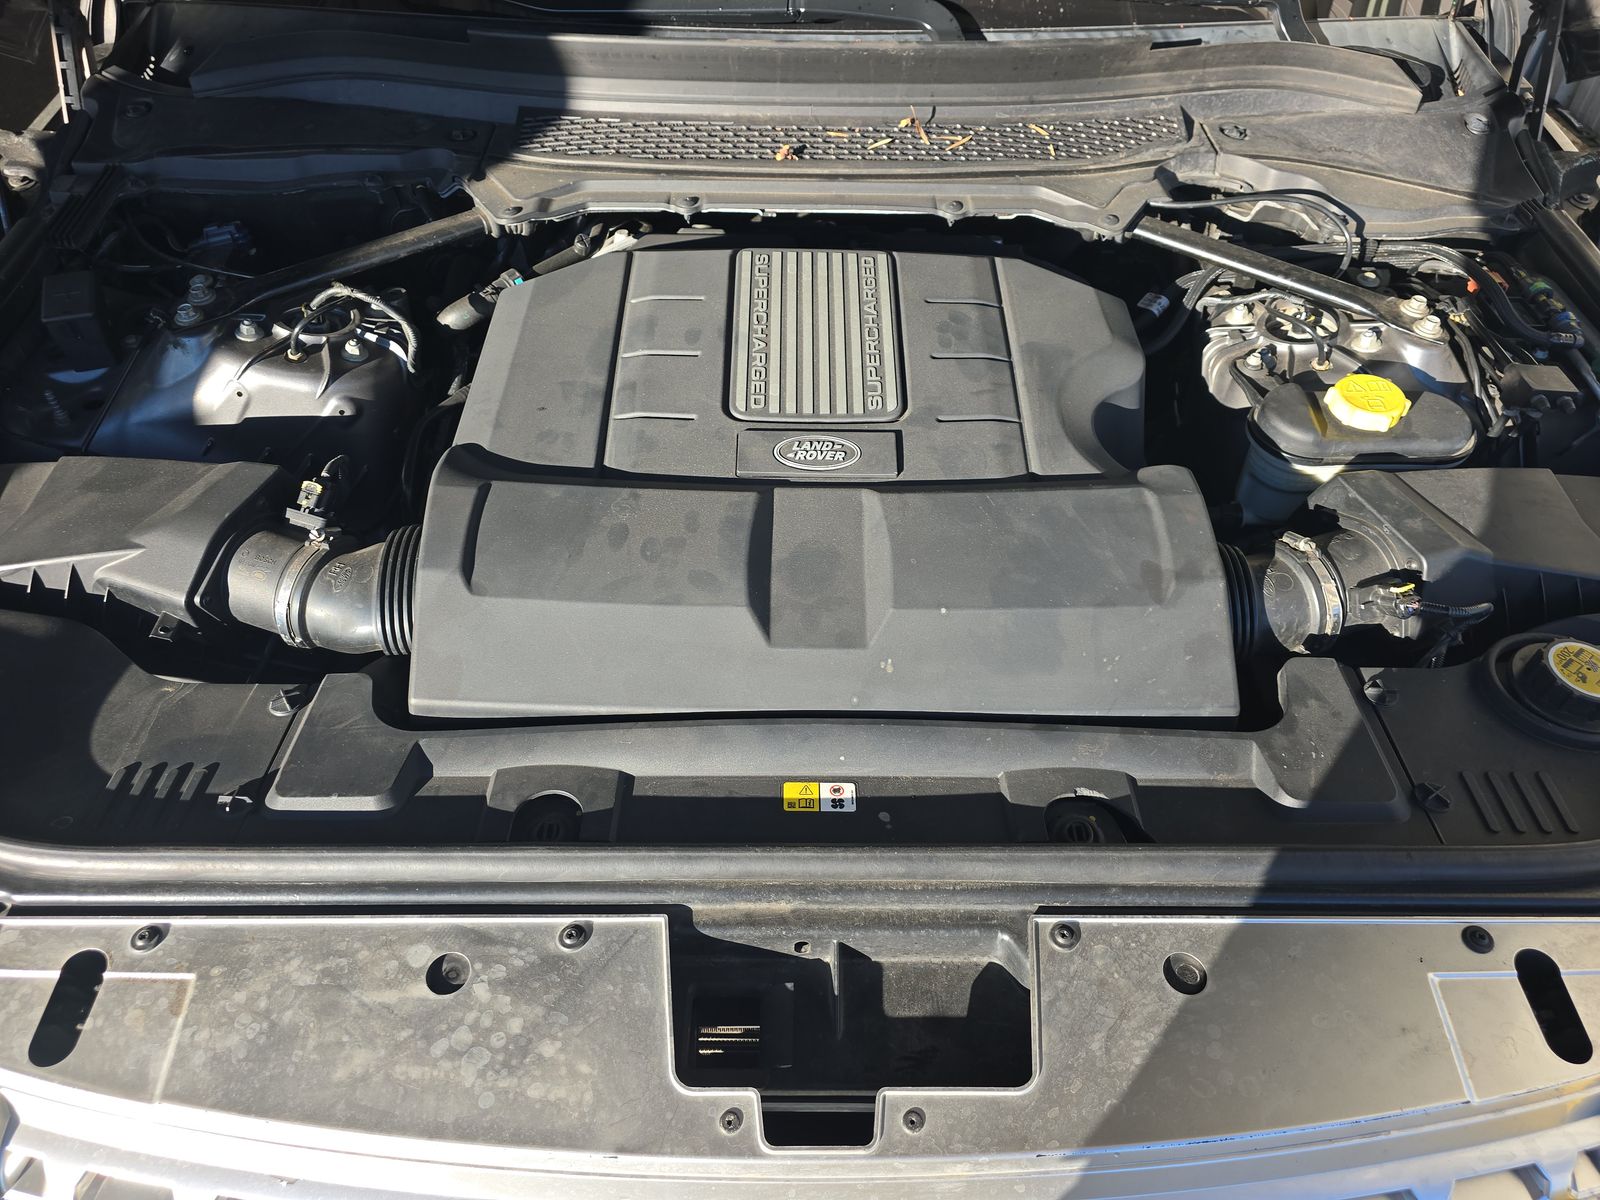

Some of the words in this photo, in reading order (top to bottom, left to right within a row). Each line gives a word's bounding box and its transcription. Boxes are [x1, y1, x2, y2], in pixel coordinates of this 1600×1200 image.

[752, 254, 769, 409] SUPERCHARGED
[862, 256, 883, 411] SUPERCHARGED
[792, 441, 834, 451] LAND
[794, 450, 846, 461] ROVER
